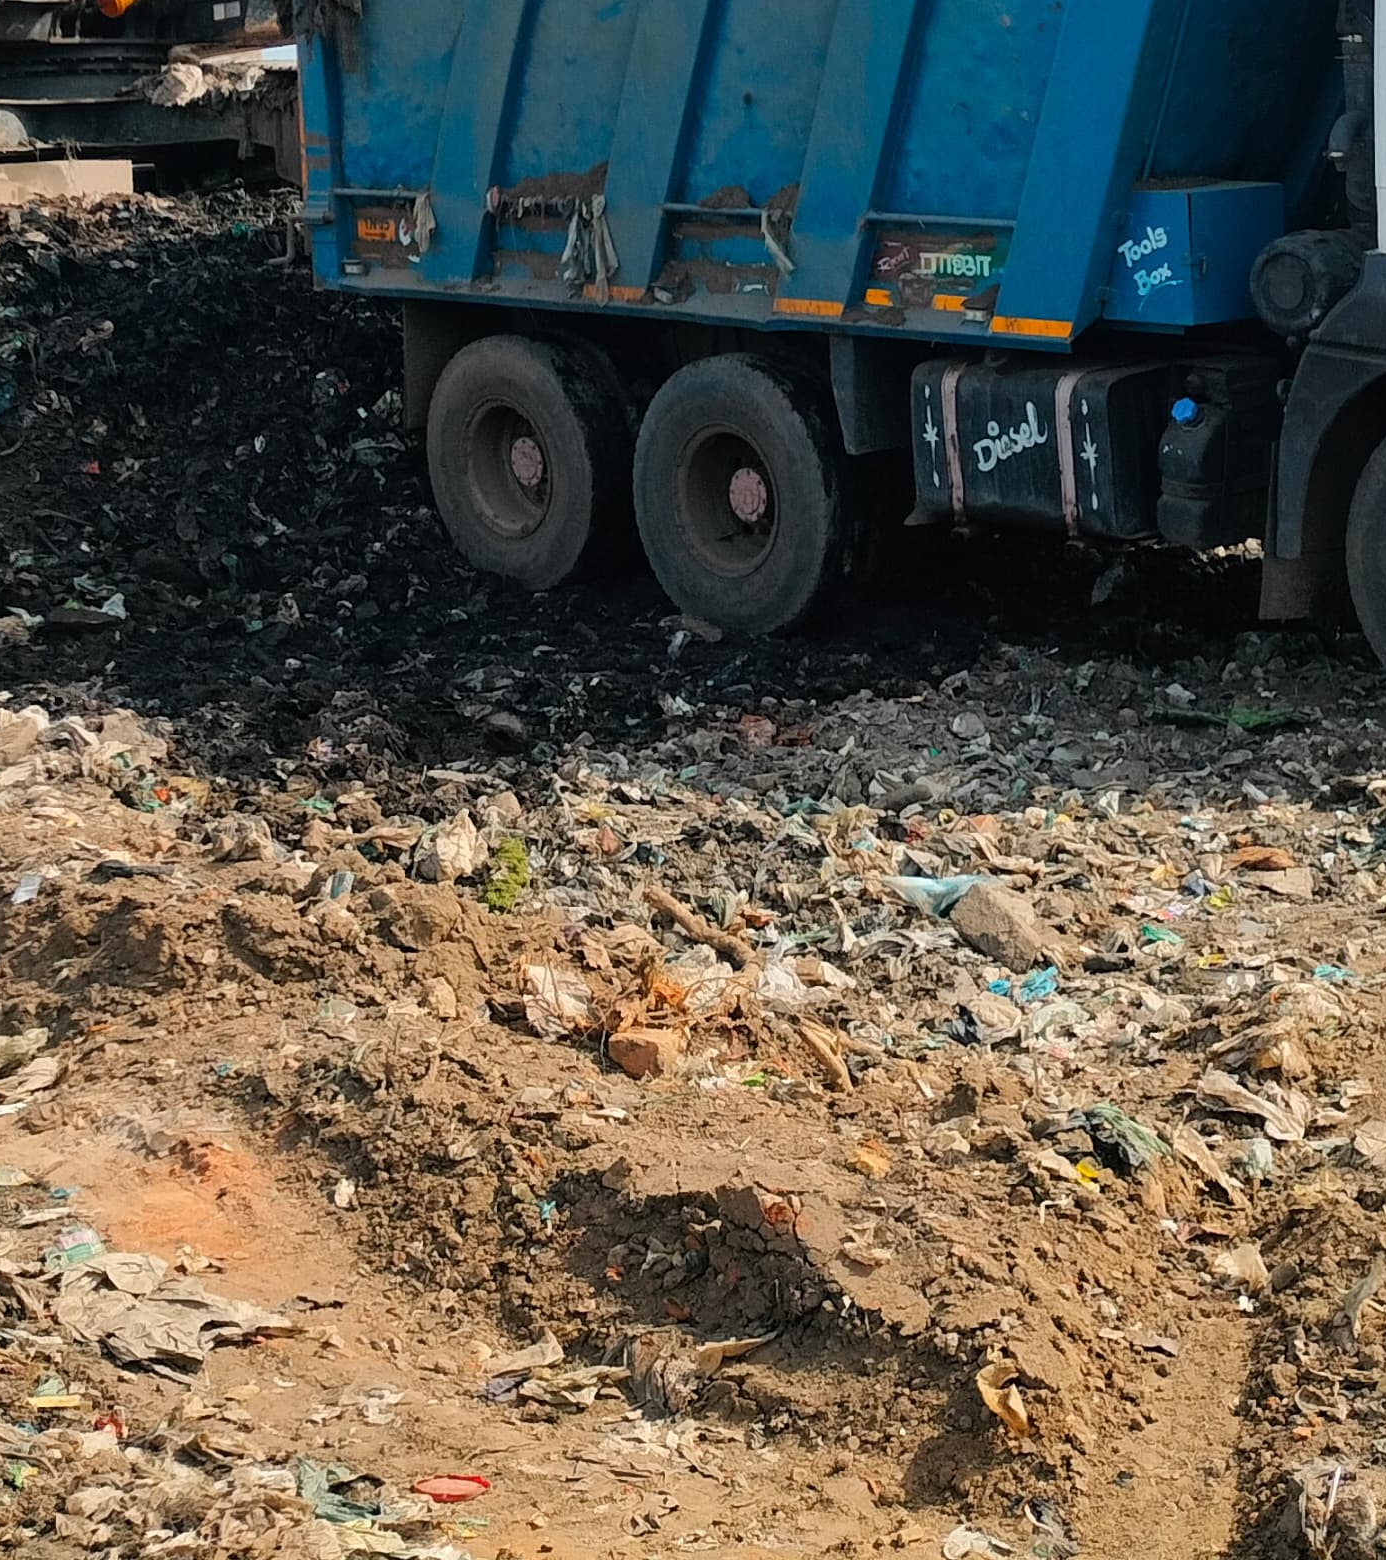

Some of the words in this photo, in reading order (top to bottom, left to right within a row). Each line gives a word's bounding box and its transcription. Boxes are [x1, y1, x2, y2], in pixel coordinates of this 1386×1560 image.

[1117, 226, 1168, 268] Tools
[1133, 262, 1173, 297] Box
[973, 400, 1049, 473] Diesel
